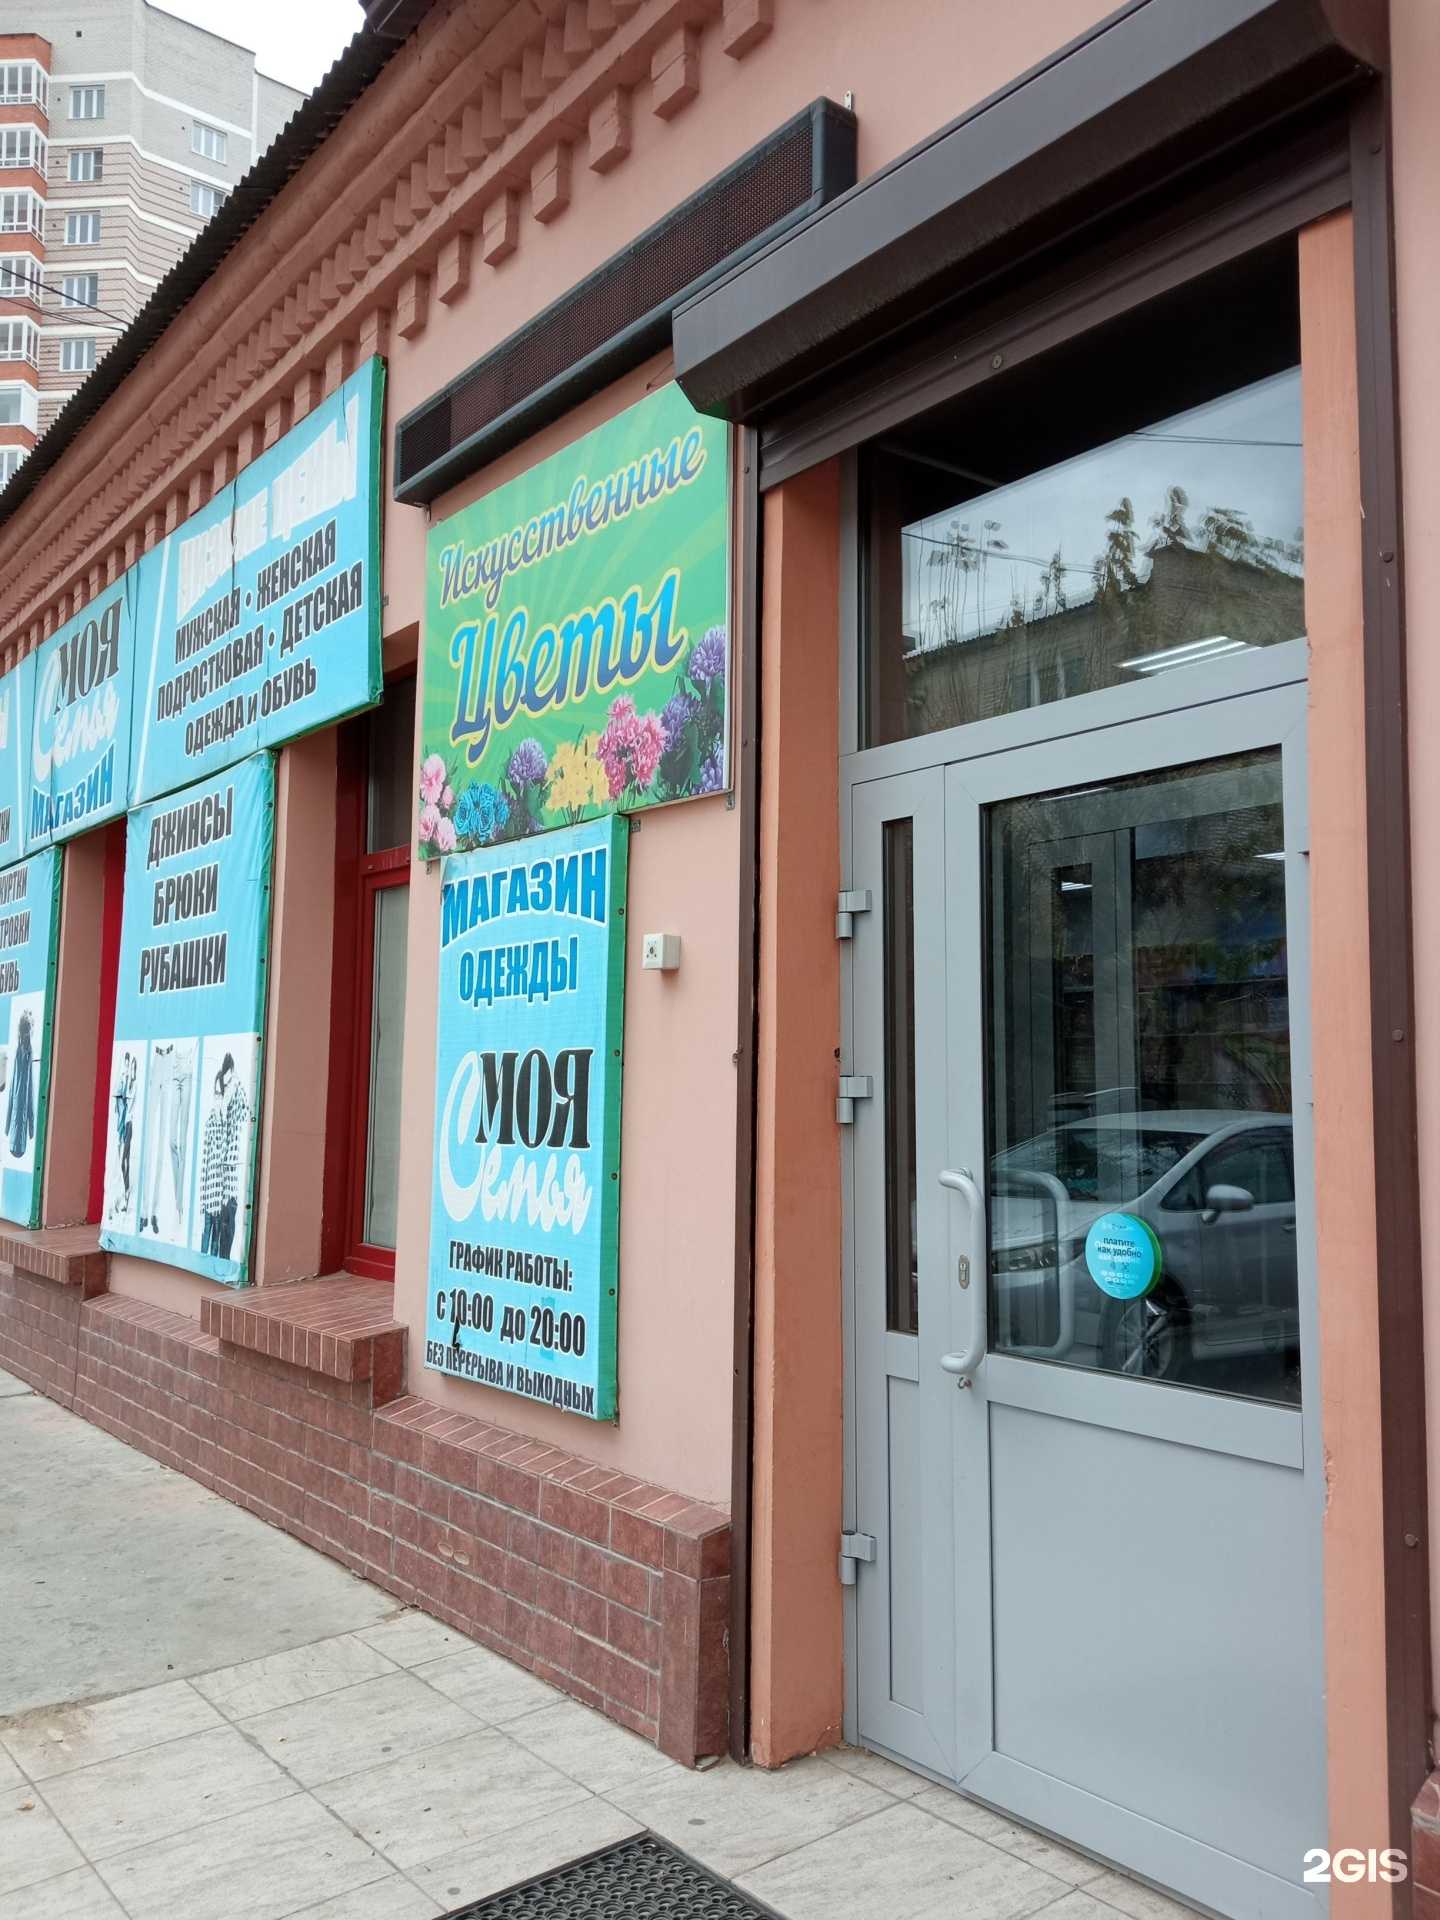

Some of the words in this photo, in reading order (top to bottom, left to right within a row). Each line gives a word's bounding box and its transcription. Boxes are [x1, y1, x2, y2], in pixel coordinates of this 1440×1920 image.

[441, 428, 706, 610] Искусственные
[157, 624, 264, 721] ПОДРОСТКОВАЯ
[280, 561, 363, 657] ДЕТСКАЯ
[176, 587, 240, 664] МУЖСКАЯ
[256, 518, 336, 612] ЖЕНСКАЯ
[54, 597, 122, 714] МОЯ
[450, 572, 687, 765] Цветы
[33, 649, 120, 783] Семья
[185, 695, 244, 756] ОДЕЖДА
[260, 657, 317, 718] ОБУВЬ
[31, 742, 115, 840] МАГАЗИН
[146, 786, 234, 870] ДЖИНСЫ
[152, 863, 219, 926] БРЮКИ
[442, 847, 607, 948] МАГАЗИН
[139, 933, 227, 994] РУБАШКИ
[459, 936, 579, 1007] ОДЕЖДЫ
[439, 1051, 593, 1235] Семья
[475, 1048, 594, 1149] МОЯ
[449, 1240, 503, 1278] ГРАФИК
[505, 1249, 573, 1291] РАБОТЫ:
[450, 1288, 494, 1333] 10:00
[530, 1305, 586, 1357] 20:00
[427, 1340, 444, 1368] БЕЗ
[446, 1346, 504, 1386] ПЕРЕРЫВА
[517, 1367, 594, 1415] ВЫХОДНЫХ
